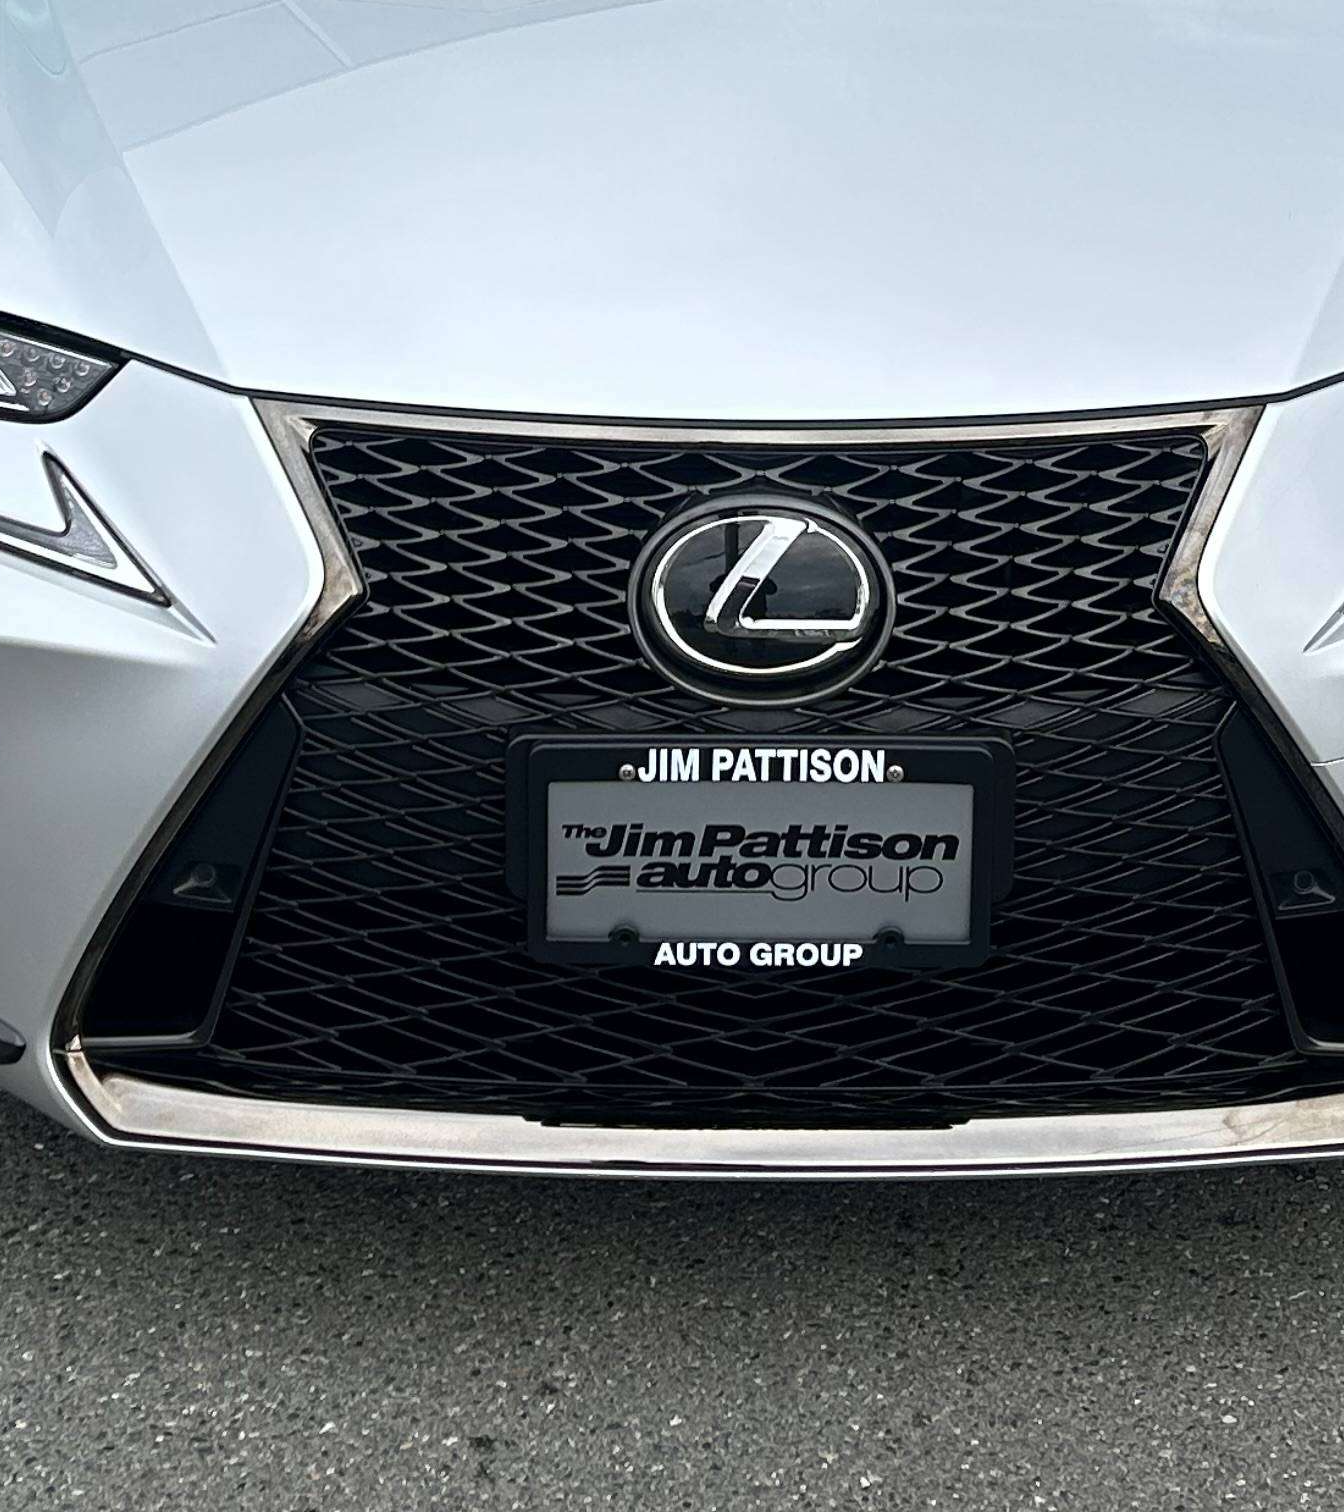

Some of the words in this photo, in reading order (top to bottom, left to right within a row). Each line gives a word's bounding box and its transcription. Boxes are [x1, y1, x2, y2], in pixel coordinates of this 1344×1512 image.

[638, 748, 700, 783] JIM
[712, 748, 885, 783] PATTISON
[562, 824, 607, 839] The
[654, 942, 741, 967] AUTO
[750, 942, 864, 967] GROUP
